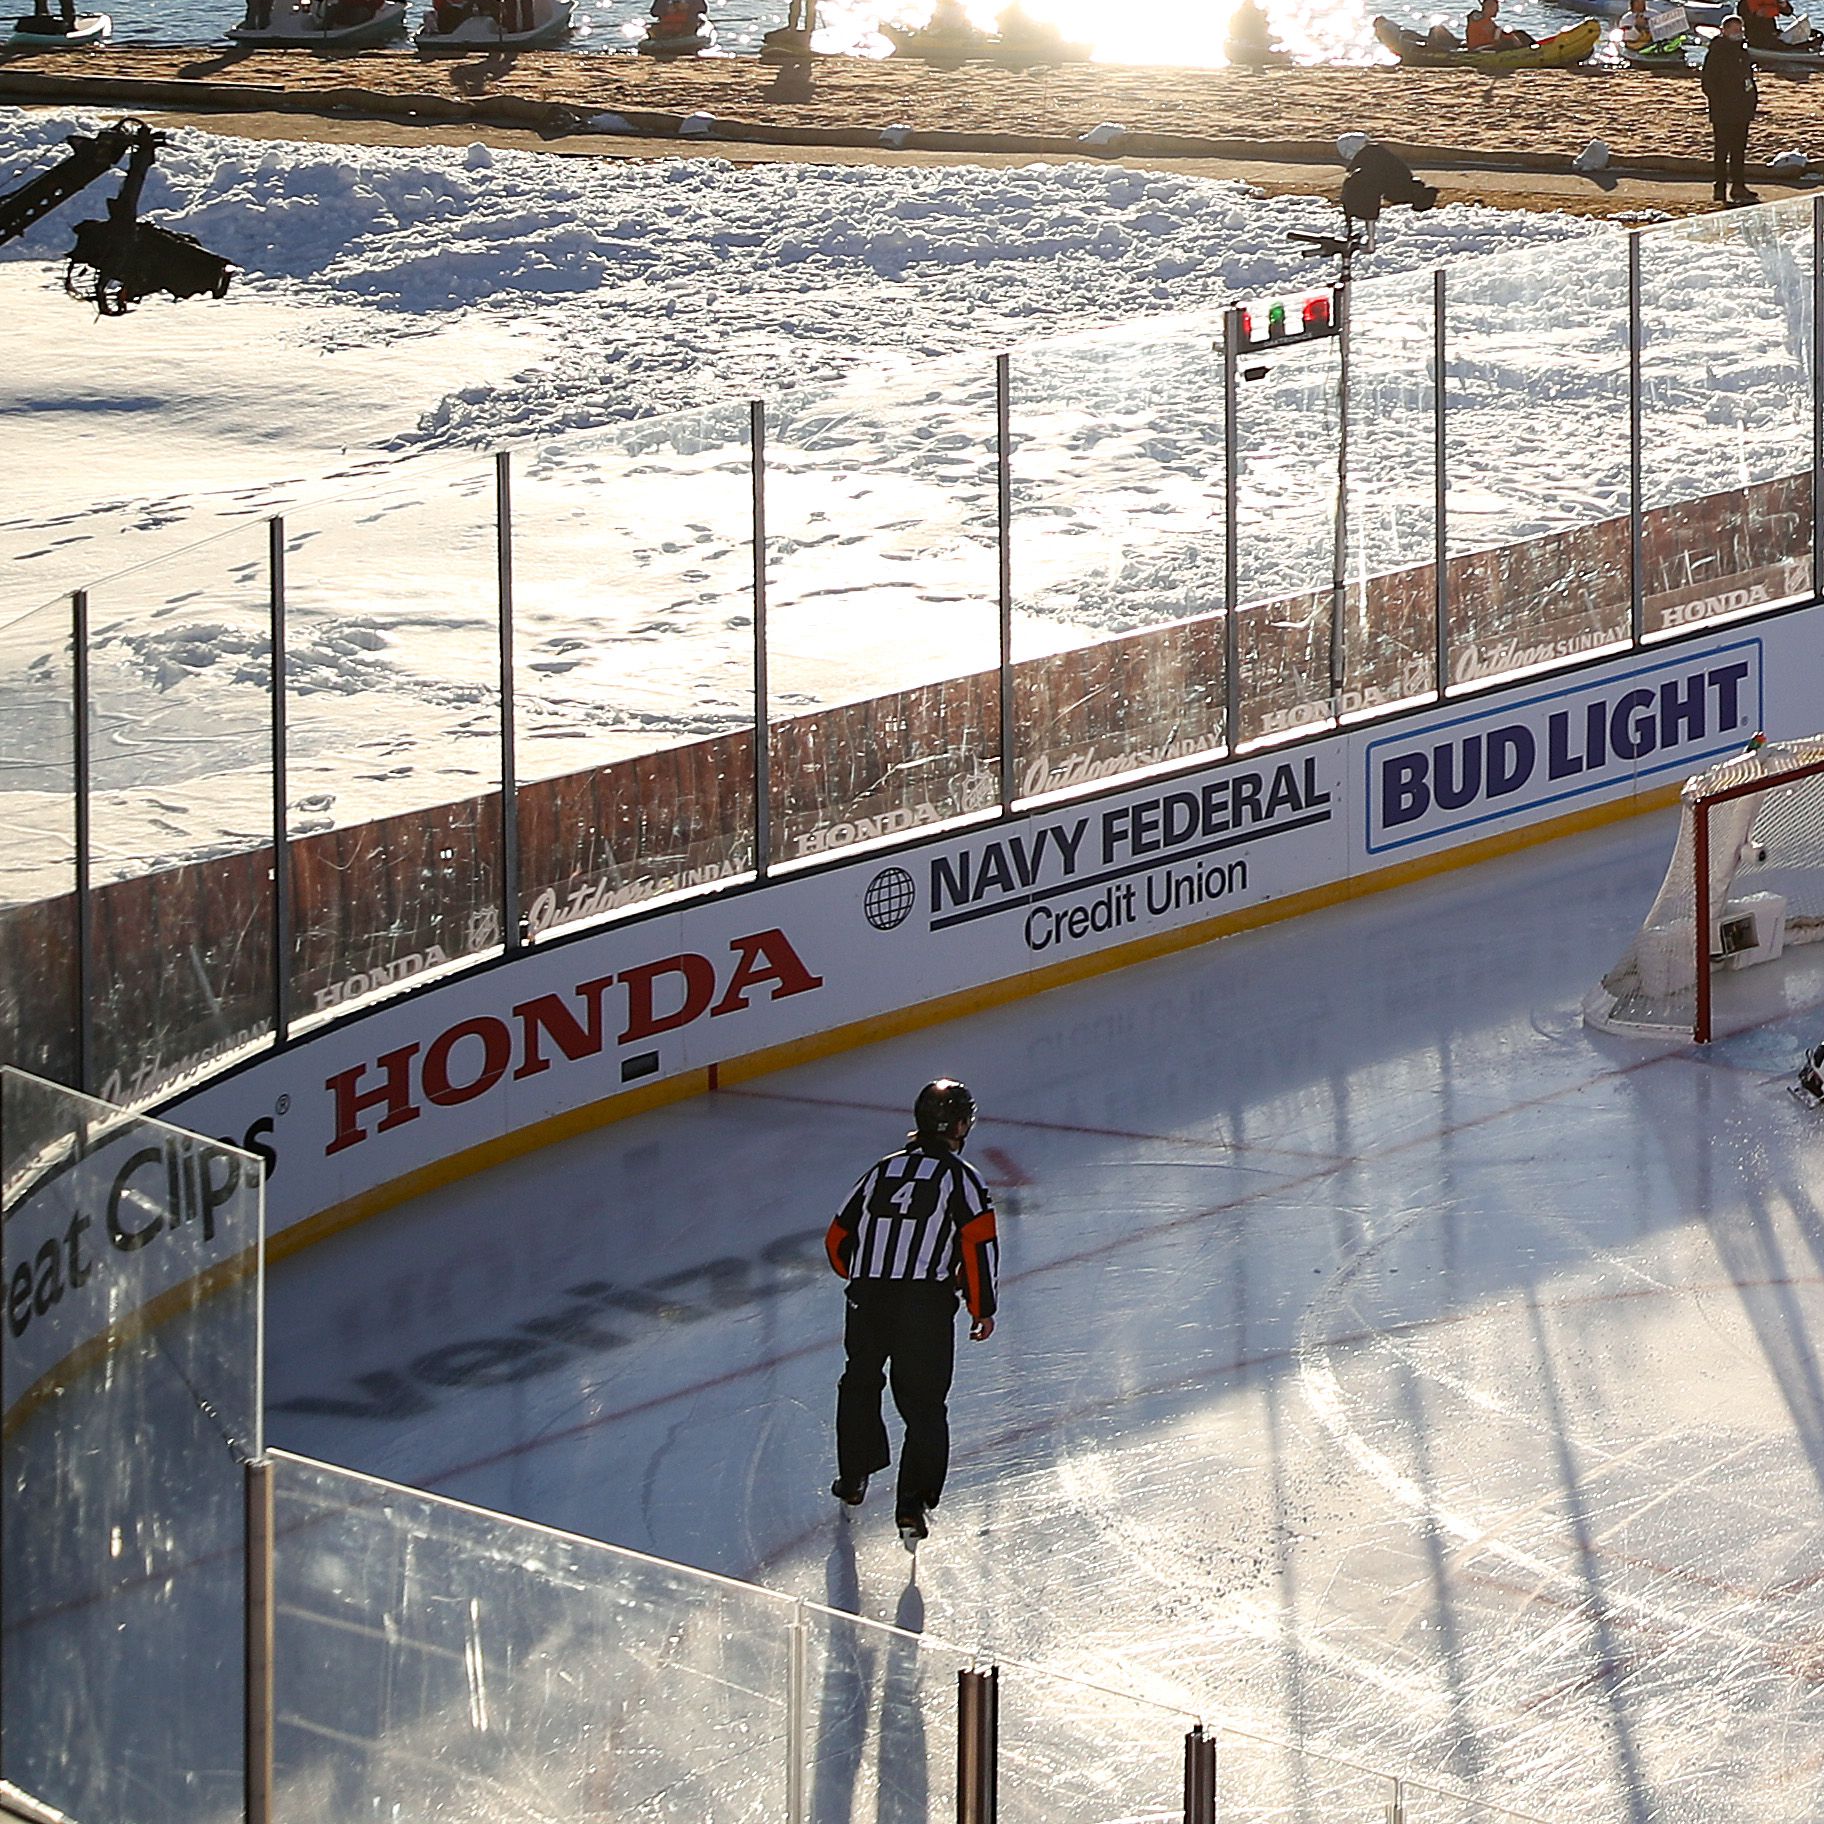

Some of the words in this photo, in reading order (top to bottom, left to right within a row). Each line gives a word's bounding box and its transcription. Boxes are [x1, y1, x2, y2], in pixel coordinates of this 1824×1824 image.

[1661, 585, 1770, 628] HONDA
[1454, 638, 1556, 683] Outdoors
[1555, 623, 1628, 658] SUNDAY
[1023, 745, 1139, 800] Outdoors
[1380, 723, 1536, 829] BUD
[1548, 662, 1749, 782] LIGHT
[798, 802, 941, 857] HONDA
[930, 817, 1092, 914] NAVY
[1102, 755, 1332, 866] FEDERAL
[528, 876, 660, 937] Outdoors
[1024, 881, 1137, 952] Credit
[1147, 858, 1249, 916] Union
[314, 944, 448, 1012] HONDA
[324, 928, 824, 1156] HONDA
[0, 1209, 93, 1338] eat
[107, 1116, 278, 1252] Clips
[889, 1180, 916, 1214] 4
[262, 1226, 850, 1422] verizo
